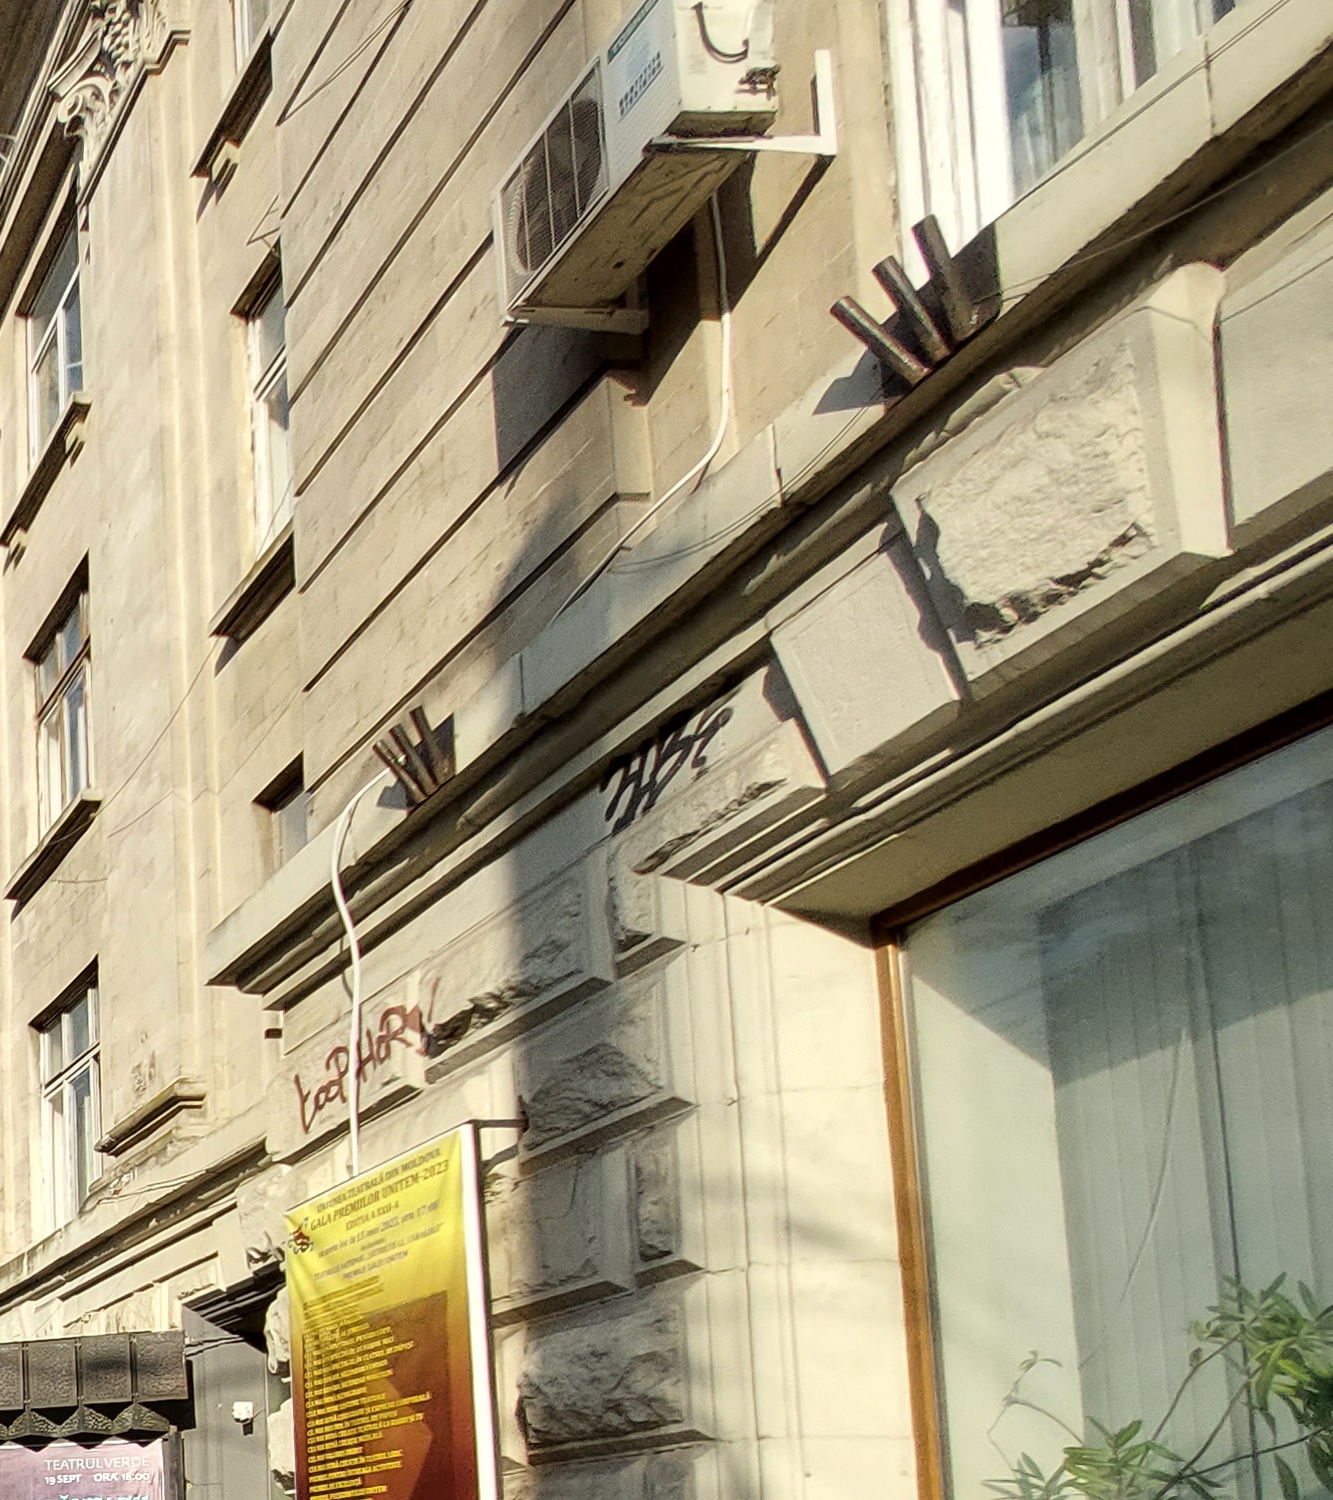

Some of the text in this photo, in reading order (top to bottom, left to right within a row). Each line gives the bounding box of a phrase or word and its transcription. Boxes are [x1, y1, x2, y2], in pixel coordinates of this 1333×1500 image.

[401, 1148, 441, 1172] MOLDOVA
[310, 1212, 331, 1231] GALA
[382, 1159, 448, 1198] UNITEM-2023
[44, 1456, 150, 1471] TEATRUL VERDE
[44, 1476, 56, 1485] 19
[57, 1473, 83, 1483] SEPT
[93, 1472, 119, 1482] ORA
